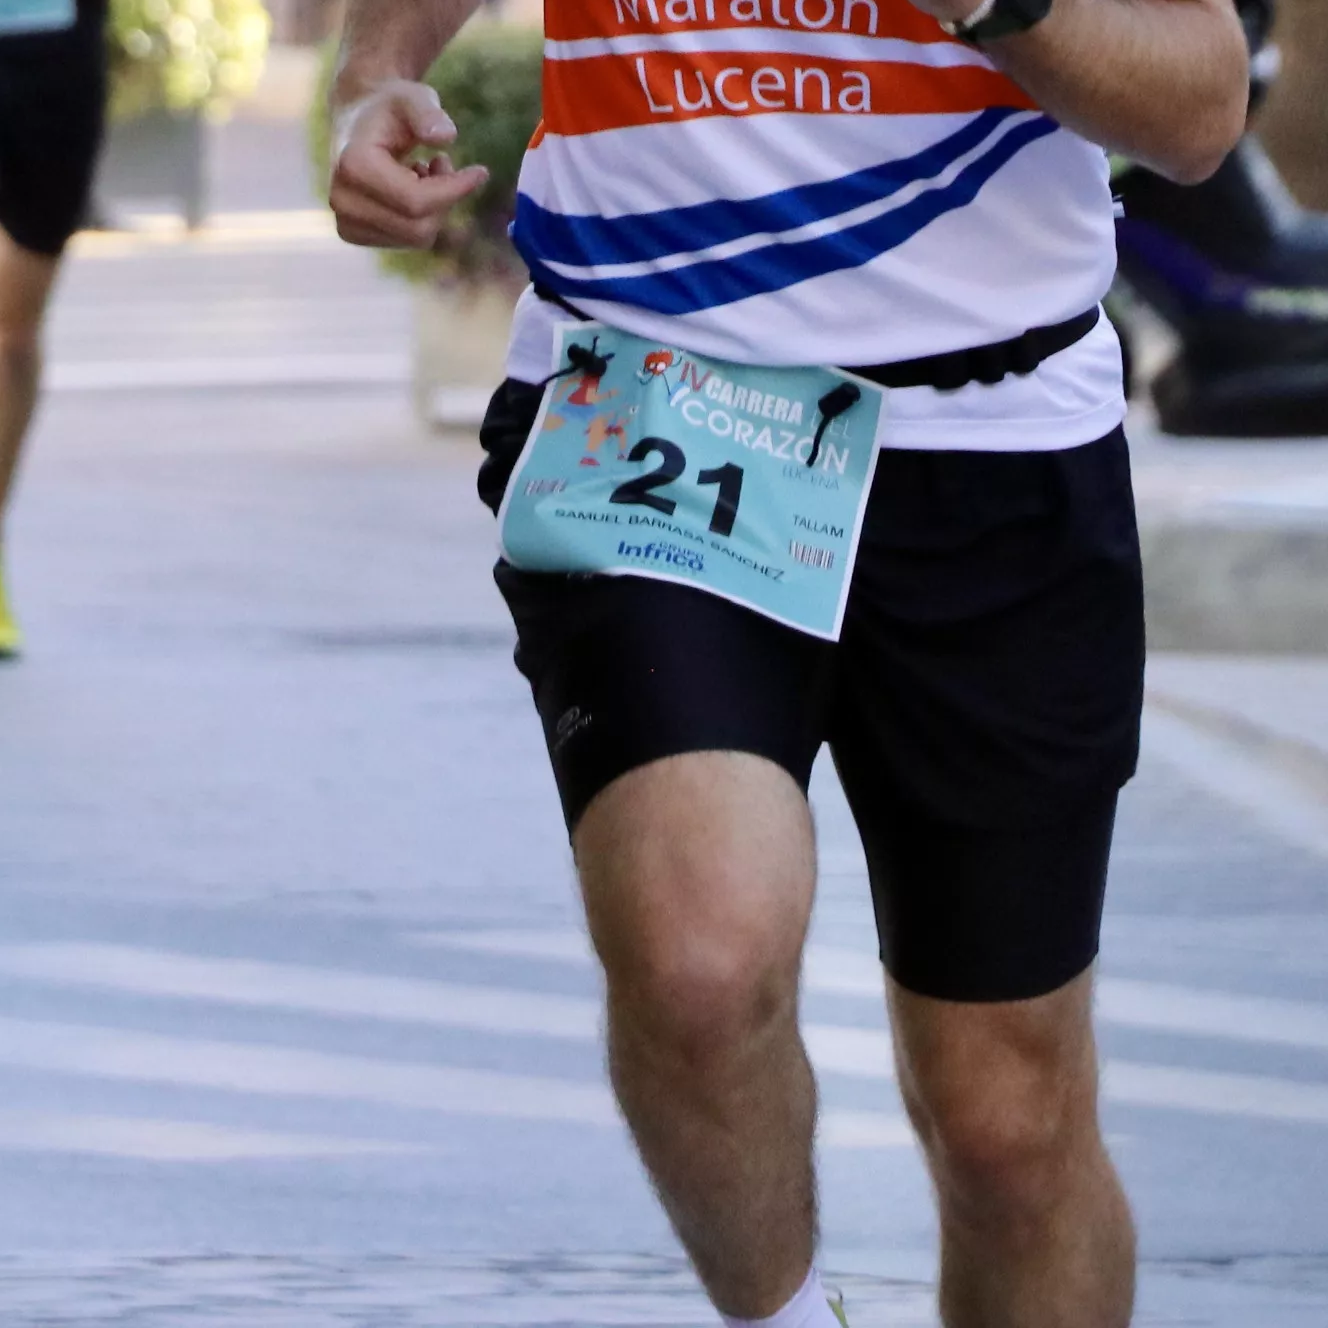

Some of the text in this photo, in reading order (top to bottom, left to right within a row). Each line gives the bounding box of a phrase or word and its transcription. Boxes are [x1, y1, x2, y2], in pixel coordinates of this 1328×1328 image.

[635, 57, 873, 114] Lucena
[704, 374, 805, 424] CARRERA
[609, 436, 744, 537] 21
[554, 508, 622, 525] SAMUEL
[617, 540, 705, 571] Infrico
